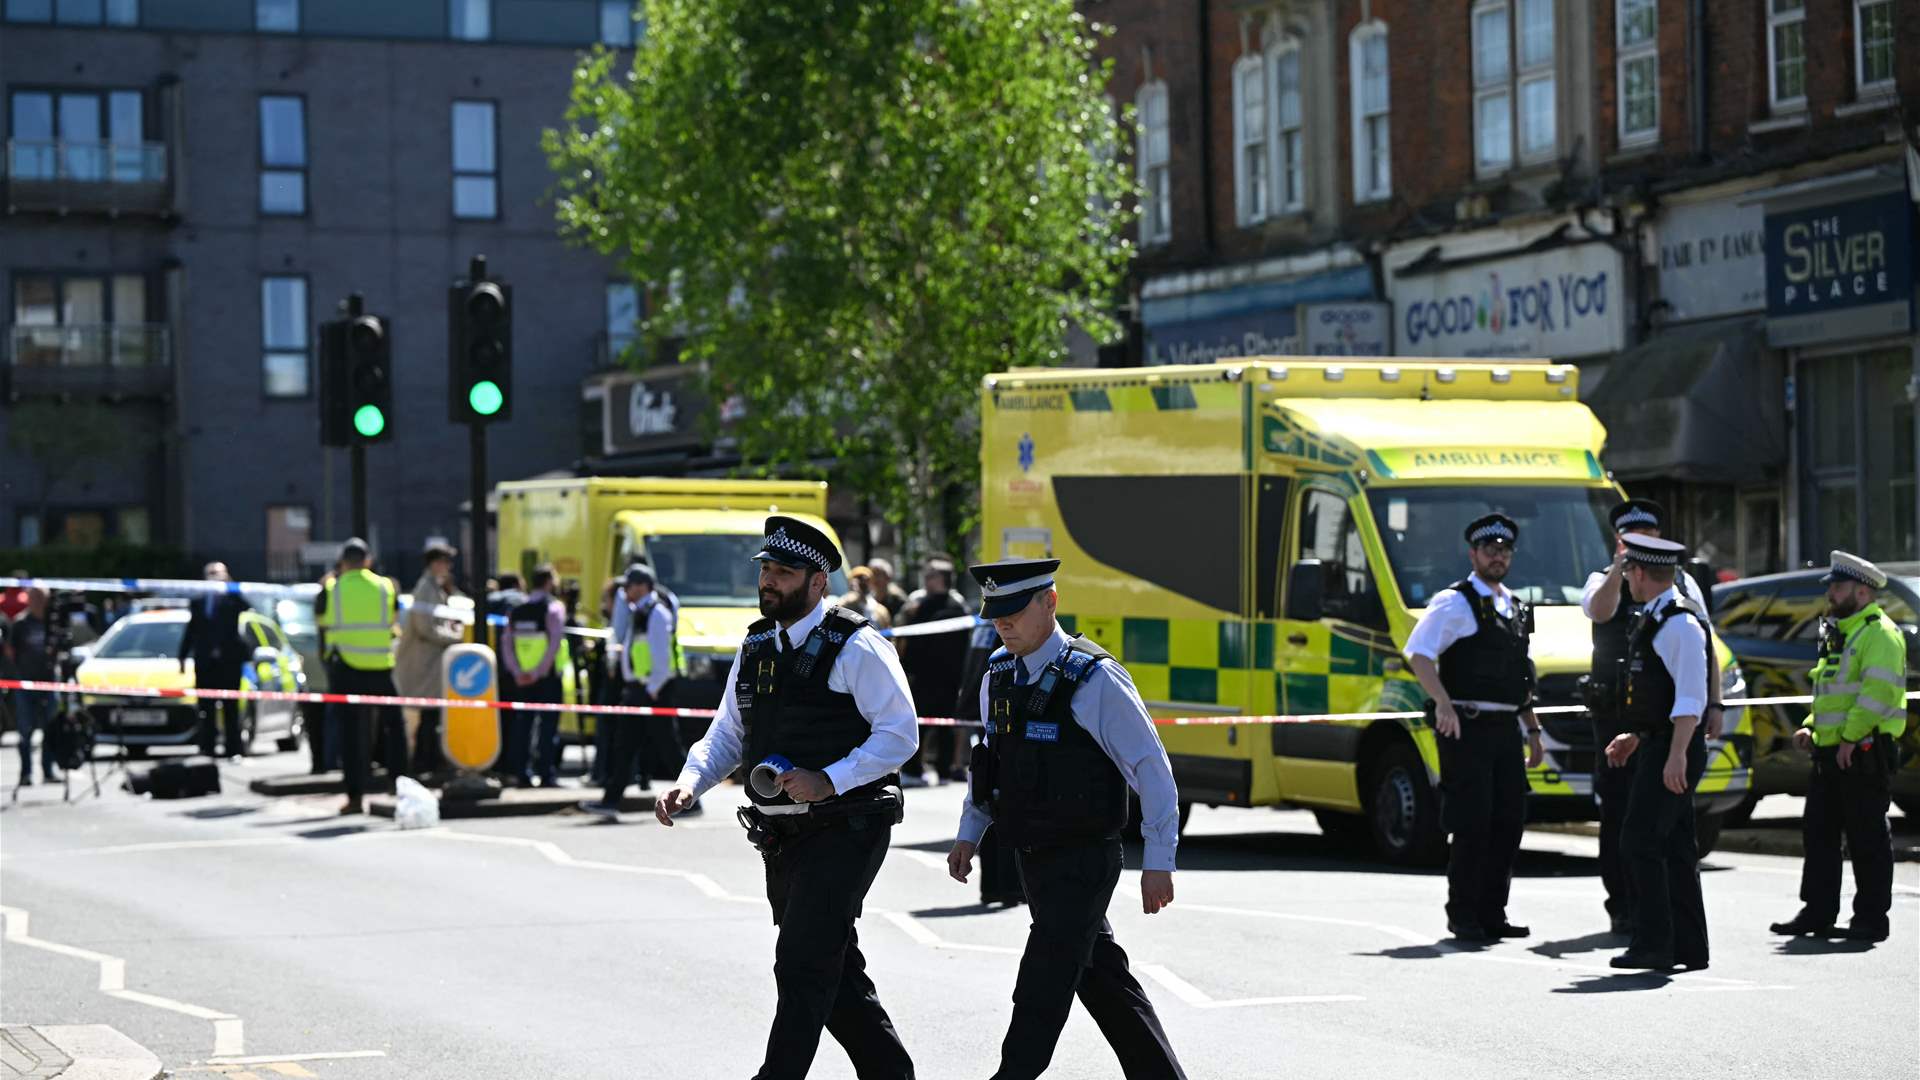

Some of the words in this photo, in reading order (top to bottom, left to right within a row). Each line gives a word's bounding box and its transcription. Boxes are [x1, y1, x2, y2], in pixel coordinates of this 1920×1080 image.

[1812, 216, 1840, 236] THE
[1784, 223, 1885, 283] SILVER
[1785, 271, 1888, 305] PLACE
[1319, 309, 1373, 324] GOOD
[1406, 294, 1472, 343] GOOD
[1506, 278, 1553, 332] FOR
[1556, 271, 1605, 329] YOU
[999, 395, 1064, 410] AMBULANCE
[1414, 452, 1559, 466] AMBULANCE
